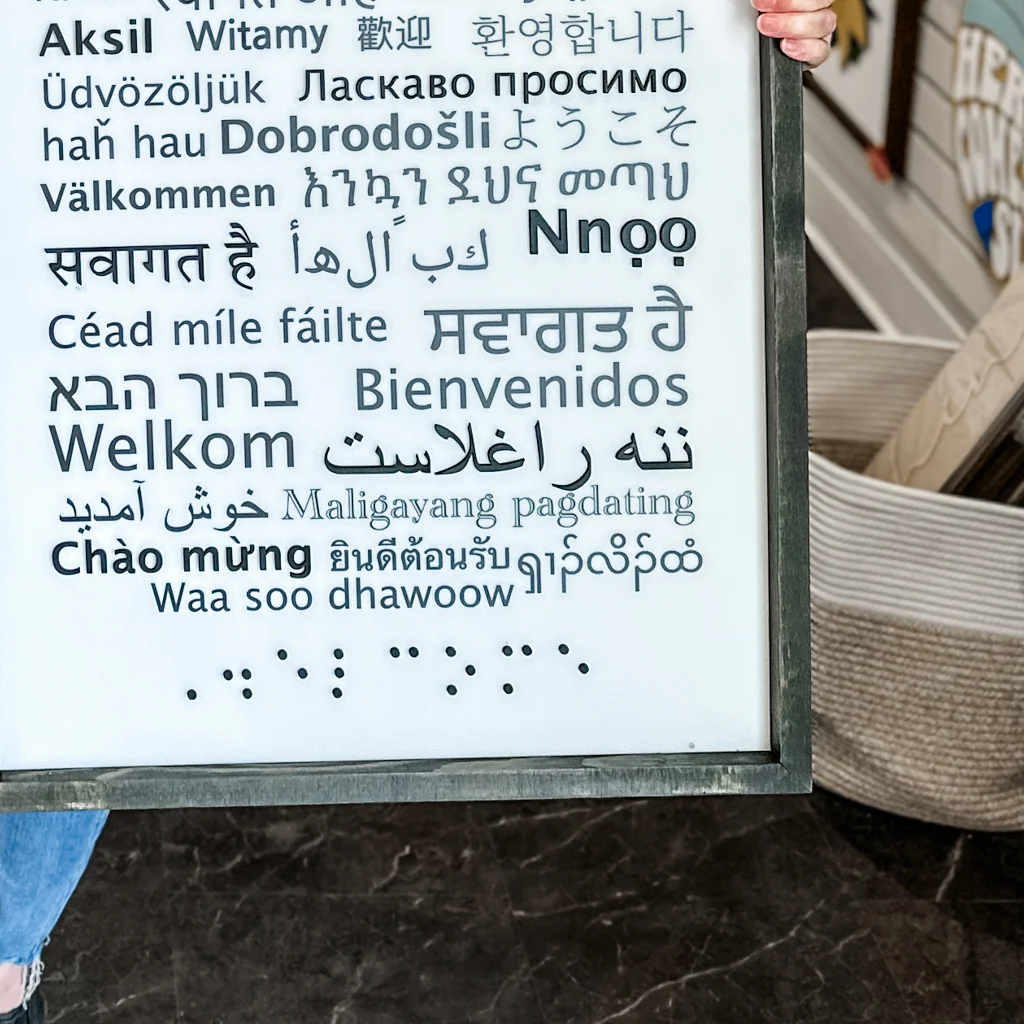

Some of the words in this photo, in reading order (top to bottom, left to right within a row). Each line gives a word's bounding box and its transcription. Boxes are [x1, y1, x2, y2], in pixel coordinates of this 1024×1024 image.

[39, 18, 152, 57] Aksil
[186, 18, 328, 54] Witamy
[357, 15, 432, 52] 歡迎
[472, 10, 694, 57] 환영합니다
[43, 71, 266, 113] Üdvözöljük
[298, 69, 475, 101] Ласкаво
[494, 68, 687, 104] просимо
[134, 125, 205, 158] hau
[221, 111, 490, 154] Dobrodošli
[504, 106, 697, 150] ようこそ
[40, 180, 275, 212] Välkommen
[224, 222, 259, 290] है
[49, 311, 153, 349] Céad
[174, 308, 262, 345] míle
[279, 307, 387, 343] fáilte
[646, 285, 693, 352] ਹੈ
[49, 374, 156, 412] הבא
[178, 371, 298, 421] ברוך
[356, 362, 688, 410] Bienvenidos
[48, 419, 294, 472] Welkom
[164, 485, 269, 532] خوش
[281, 488, 497, 531] Maligayang
[512, 484, 695, 528] pagdating
[51, 538, 163, 575] Chào
[182, 536, 311, 579] mừng
[330, 536, 510, 571] ยินดีต้อนรับ
[151, 582, 231, 612] Waa
[246, 587, 312, 611] soo
[329, 577, 514, 610] dhawoow
